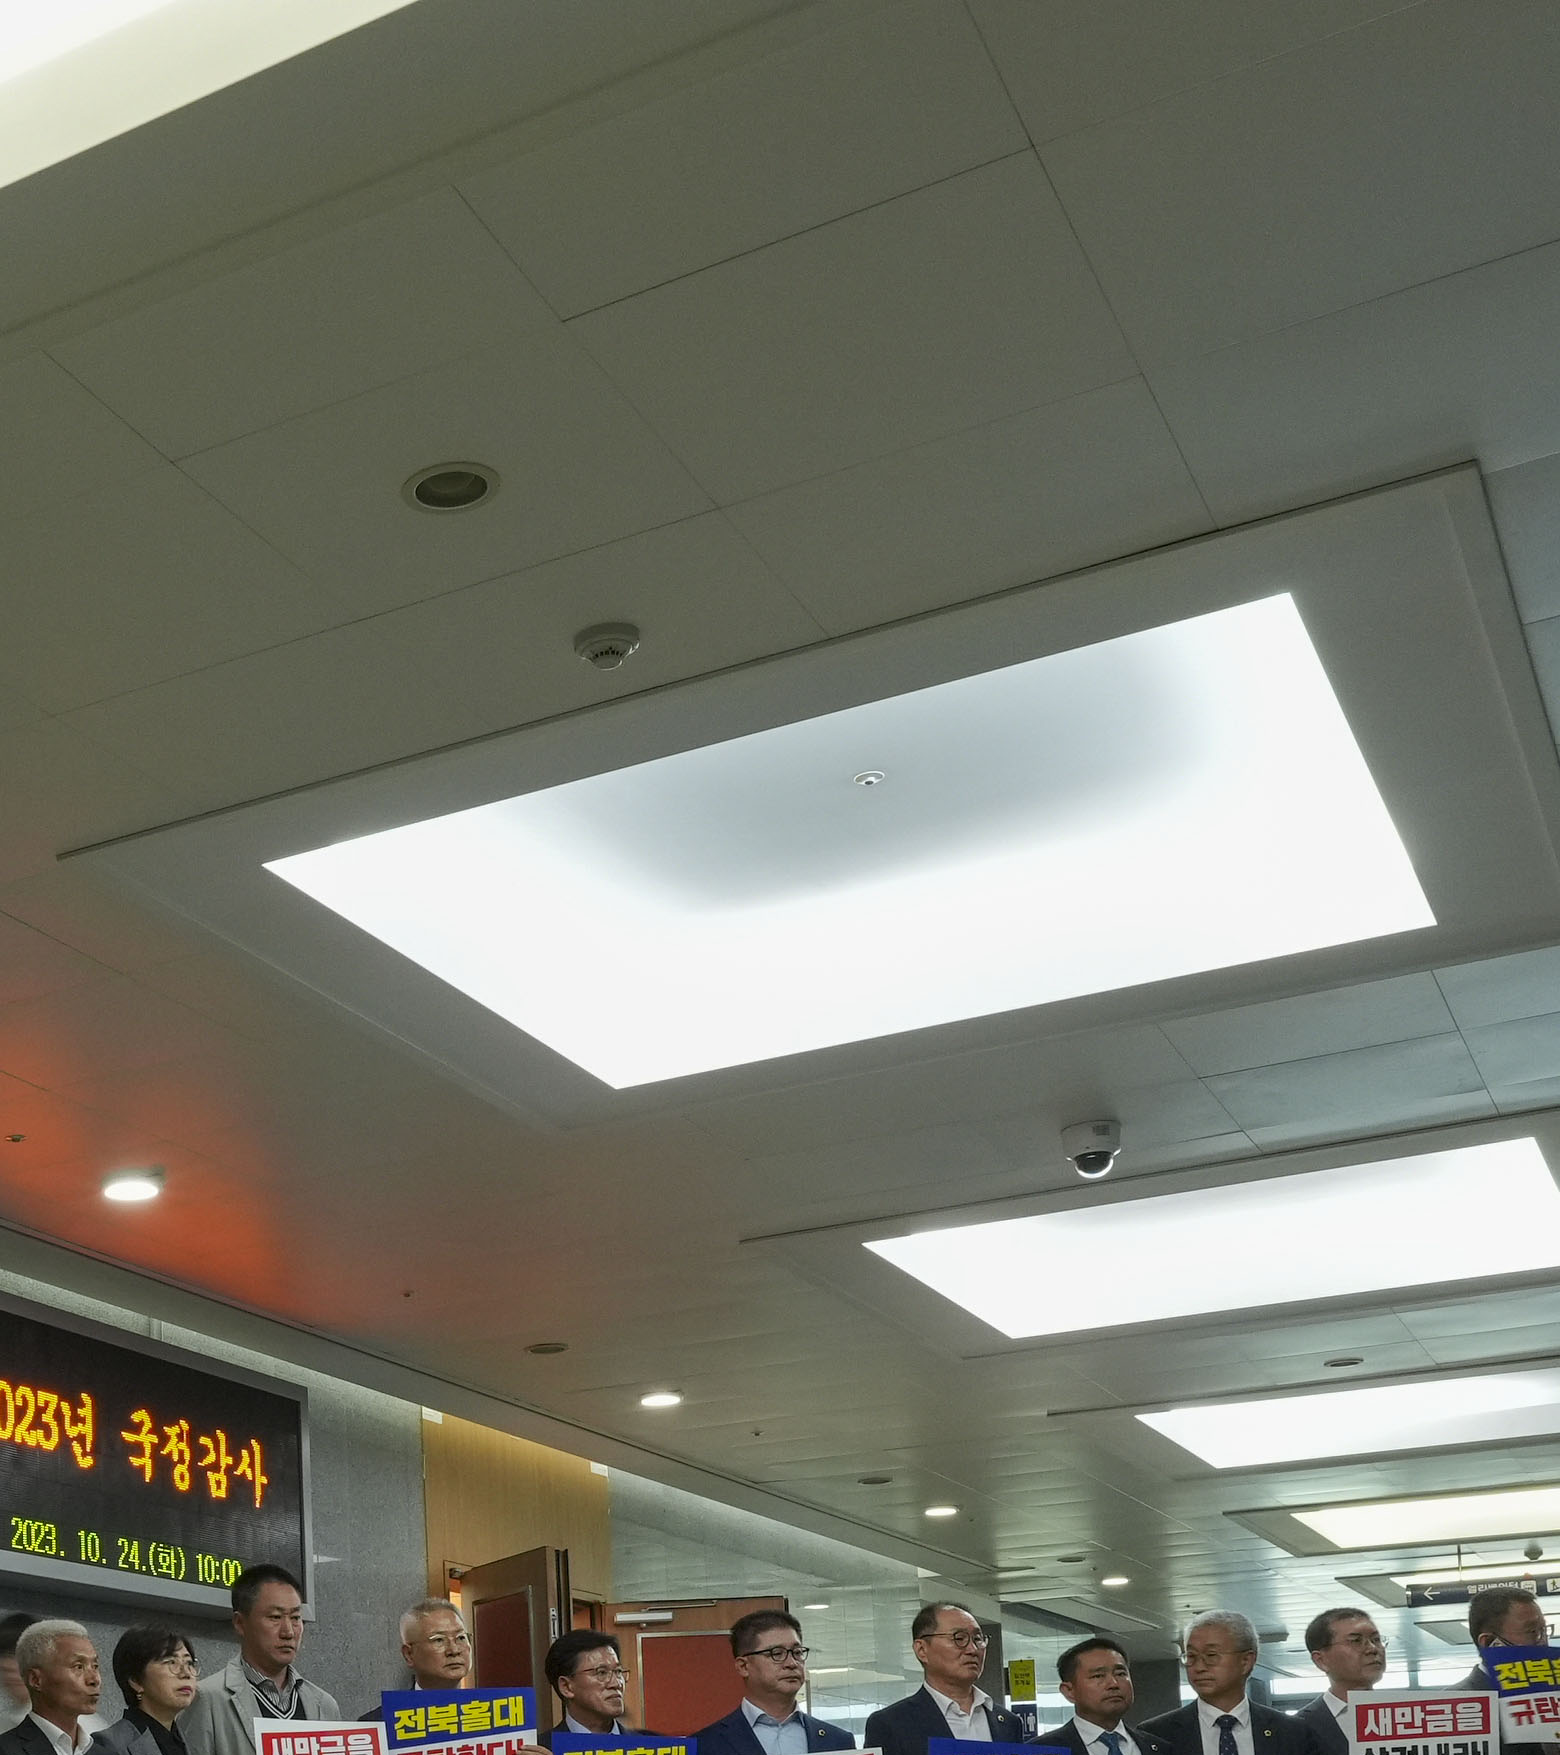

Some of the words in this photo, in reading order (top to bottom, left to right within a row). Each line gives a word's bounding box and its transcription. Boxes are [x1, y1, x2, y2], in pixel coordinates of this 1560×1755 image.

[120, 1407, 269, 1509] 국정감사
[10, 1516, 66, 1557] 2023.
[77, 1529, 107, 1566] 10.
[394, 1695, 524, 1740] 전북홀대
[1364, 1700, 1484, 1736] 새만금을
